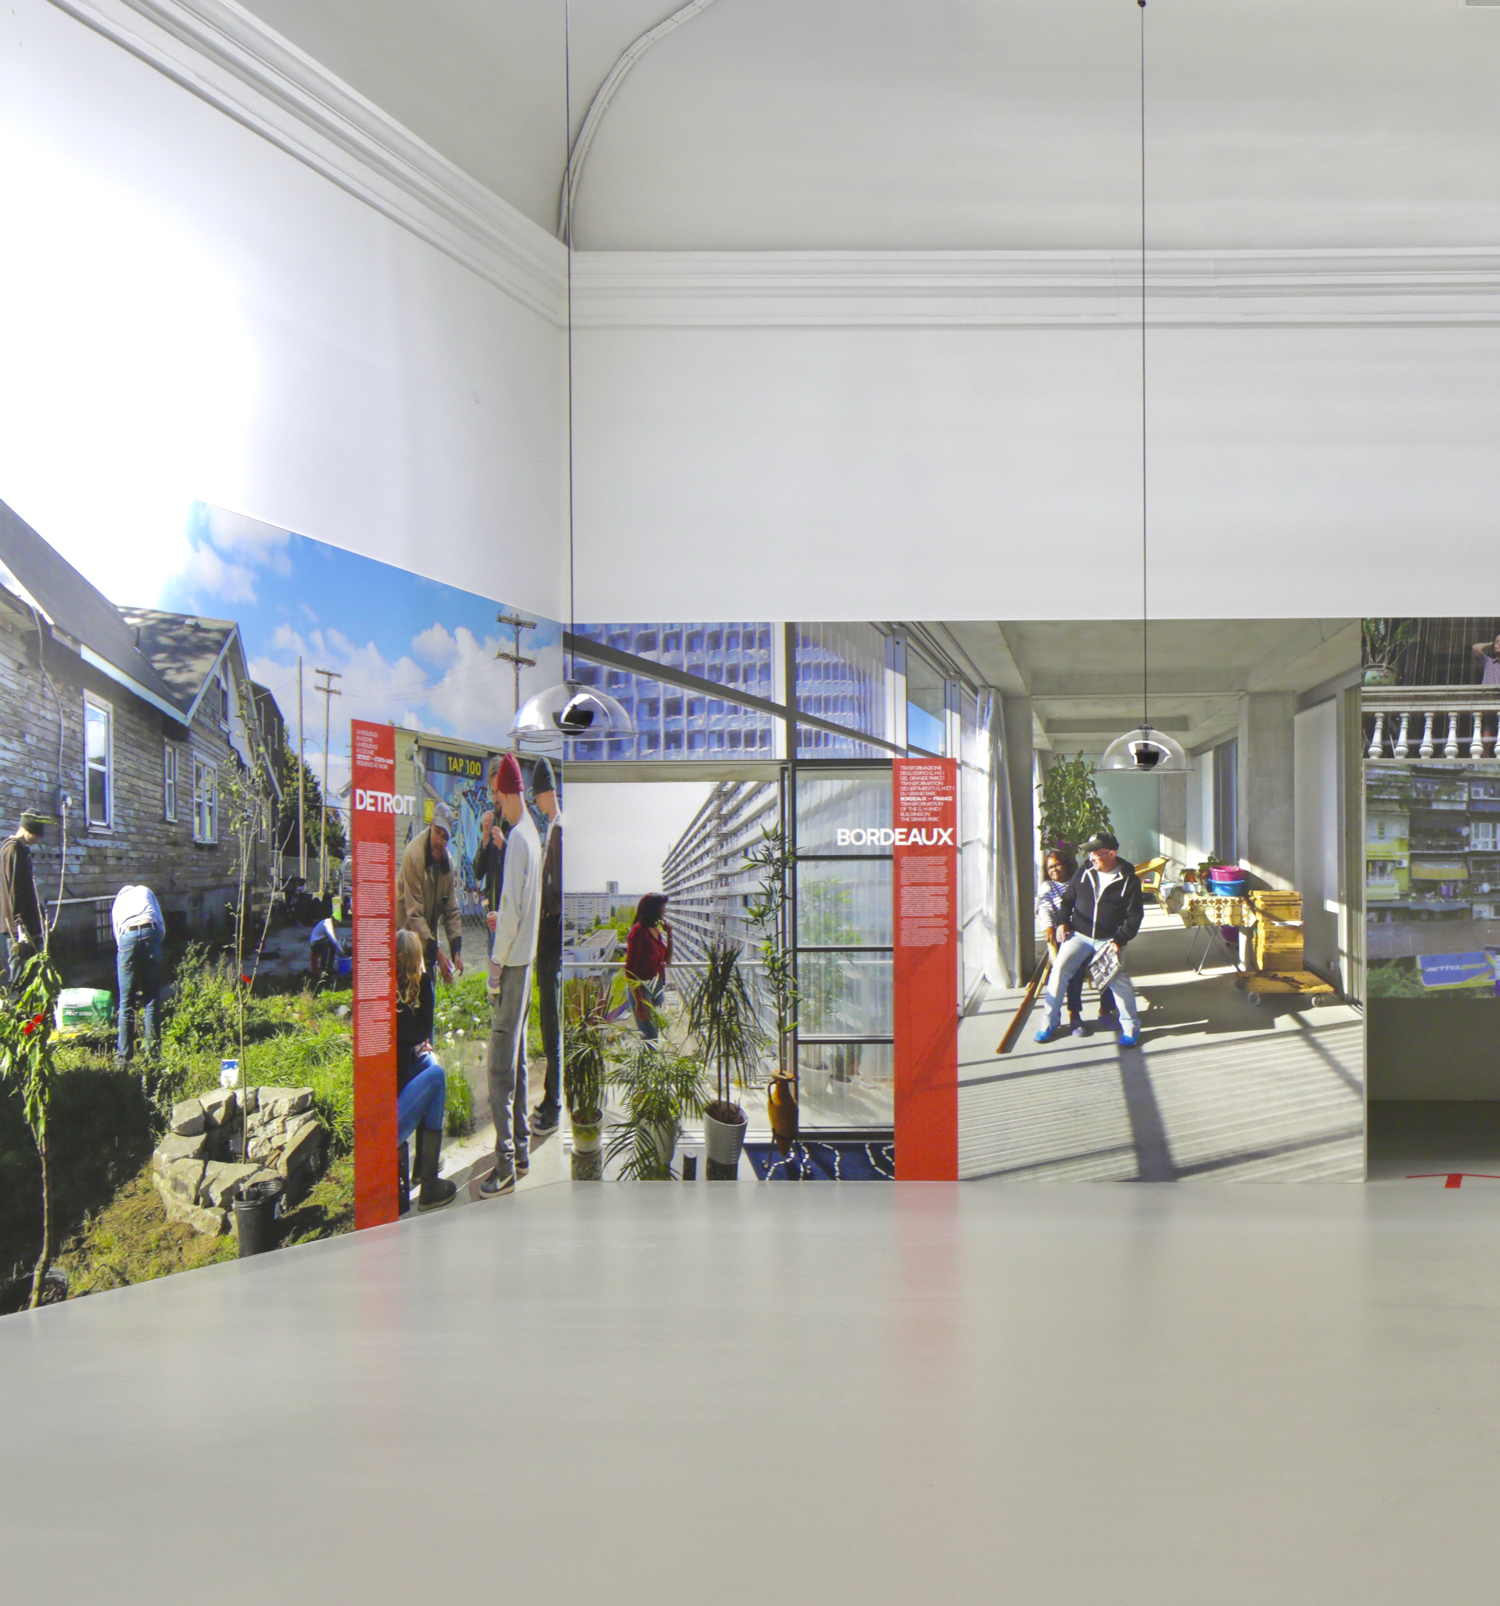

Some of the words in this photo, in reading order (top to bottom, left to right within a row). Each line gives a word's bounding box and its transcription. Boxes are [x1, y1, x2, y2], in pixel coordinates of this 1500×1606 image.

[448, 756, 464, 772] TAP
[466, 760, 482, 776] 100
[355, 789, 416, 815] DETROIT
[837, 828, 954, 846] BORDEAUX
